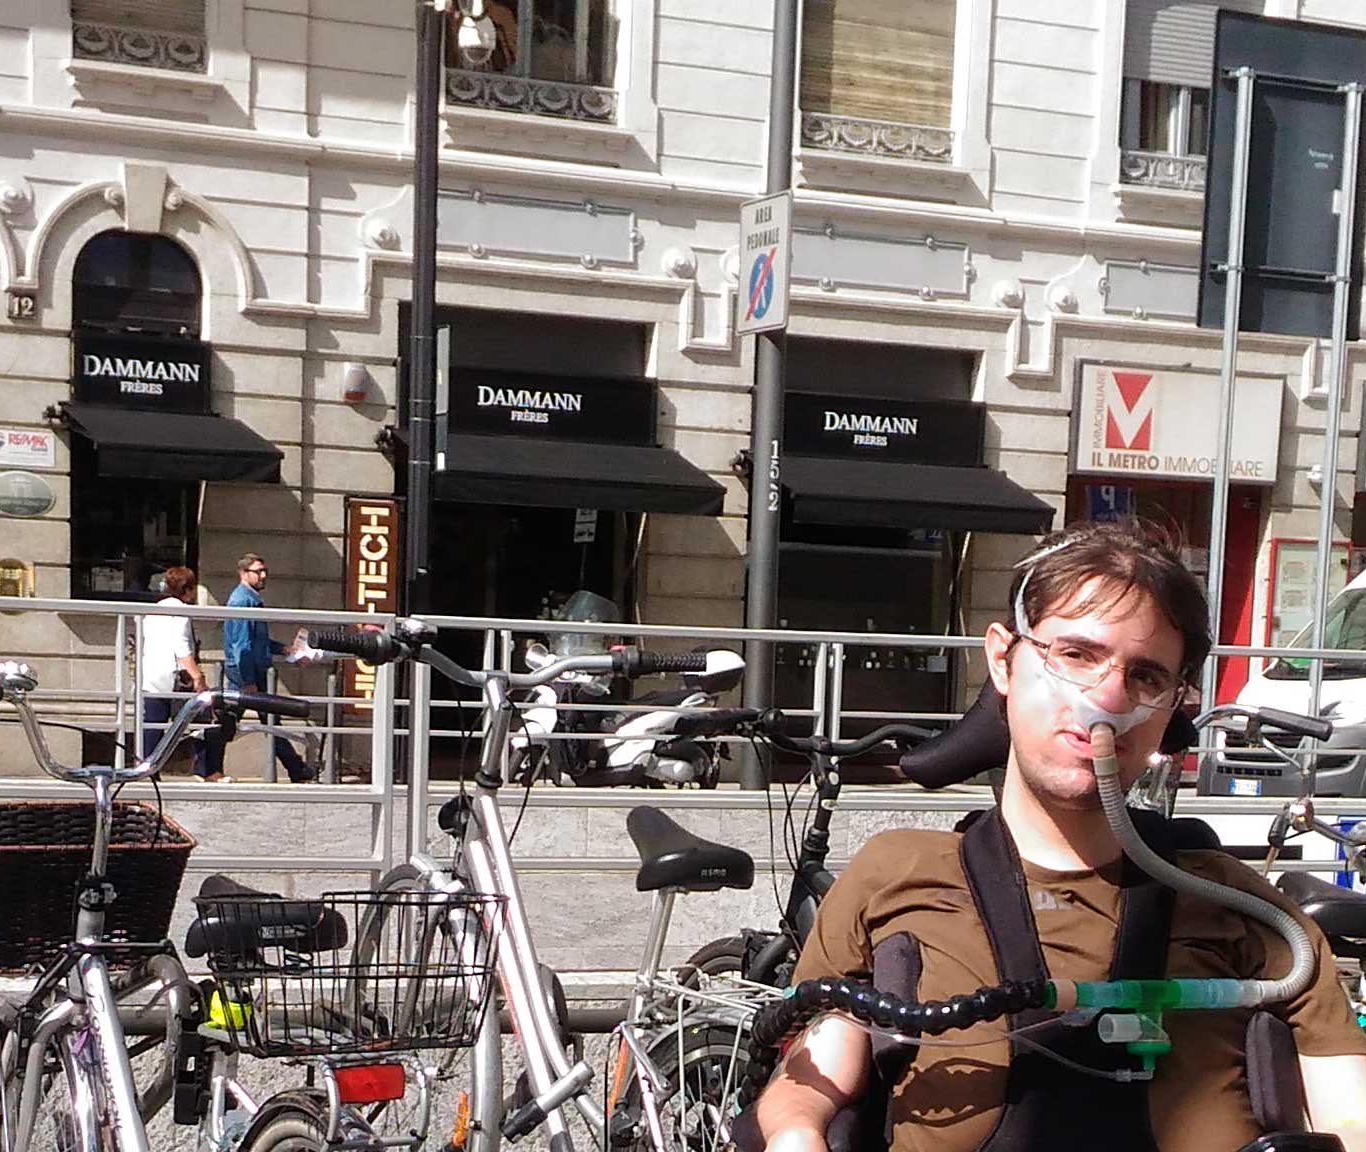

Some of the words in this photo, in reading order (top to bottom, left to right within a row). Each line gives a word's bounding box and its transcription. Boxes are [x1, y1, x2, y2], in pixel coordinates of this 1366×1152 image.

[754, 205, 773, 226] AREA
[746, 230, 781, 251] PEDONALE
[12, 296, 34, 316] 12
[84, 354, 201, 382] DAMMANN
[477, 385, 582, 411] DAMMANN
[824, 411, 918, 434] DAMMANN
[1091, 452, 1103, 467] IL
[1108, 454, 1159, 471] METRO
